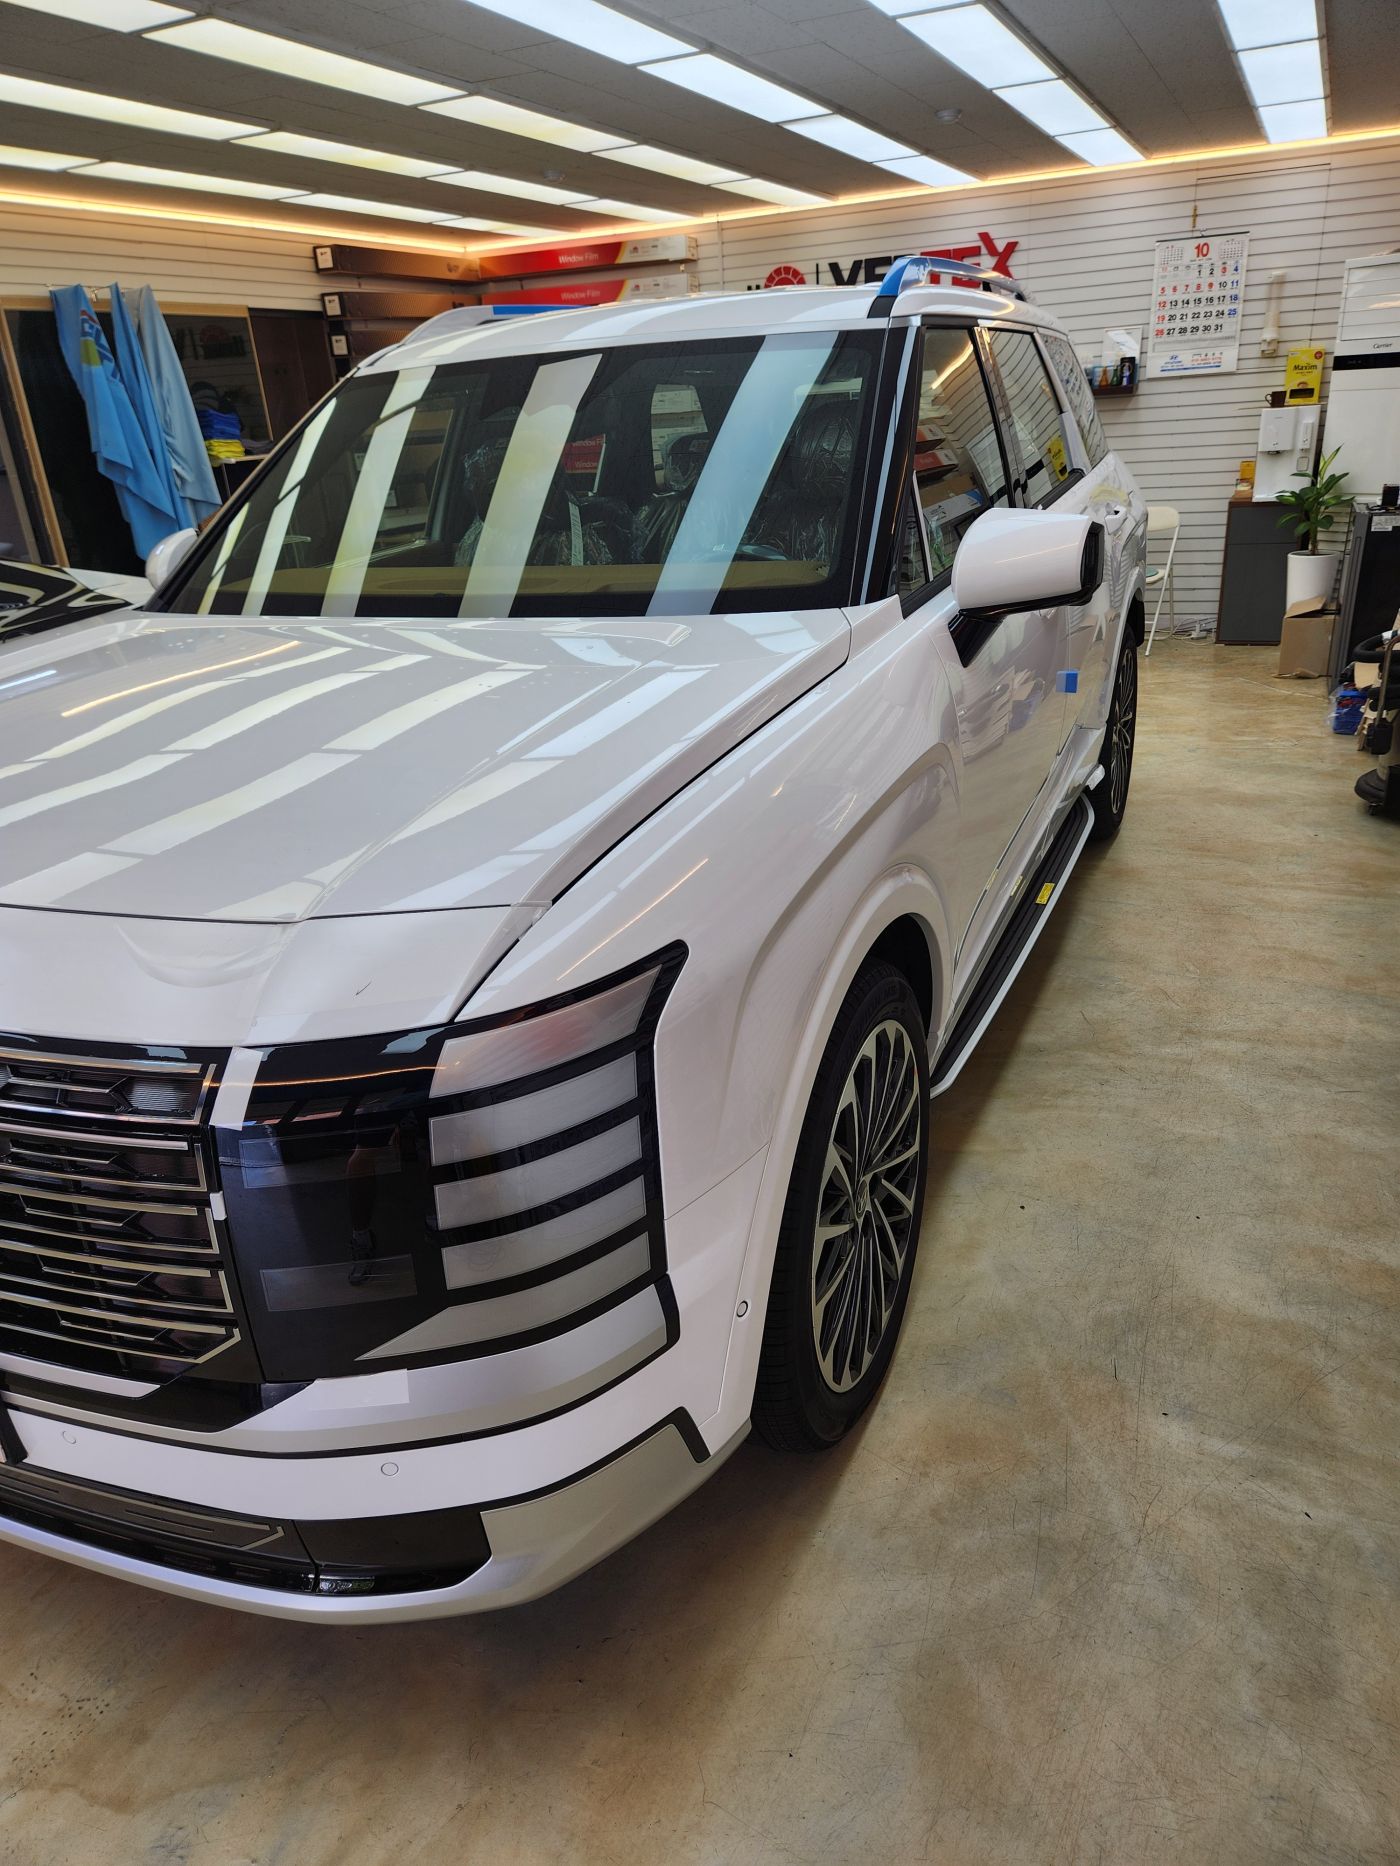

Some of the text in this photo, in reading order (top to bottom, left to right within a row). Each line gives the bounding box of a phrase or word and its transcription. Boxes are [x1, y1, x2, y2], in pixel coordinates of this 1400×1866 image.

[1194, 242, 1210, 258] 10
[558, 252, 599, 264] Window Film
[828, 231, 1019, 291] VETEX
[1230, 279, 1239, 287] 11
[561, 289, 601, 301] Window Film
[1169, 299, 1178, 307] 13
[1181, 298, 1190, 306] 14
[1193, 297, 1202, 305] 15
[1205, 296, 1214, 304] 16
[1215, 309, 1225, 317] 24
[1227, 308, 1237, 316] 25
[1293, 363, 1318, 371] Maxim
